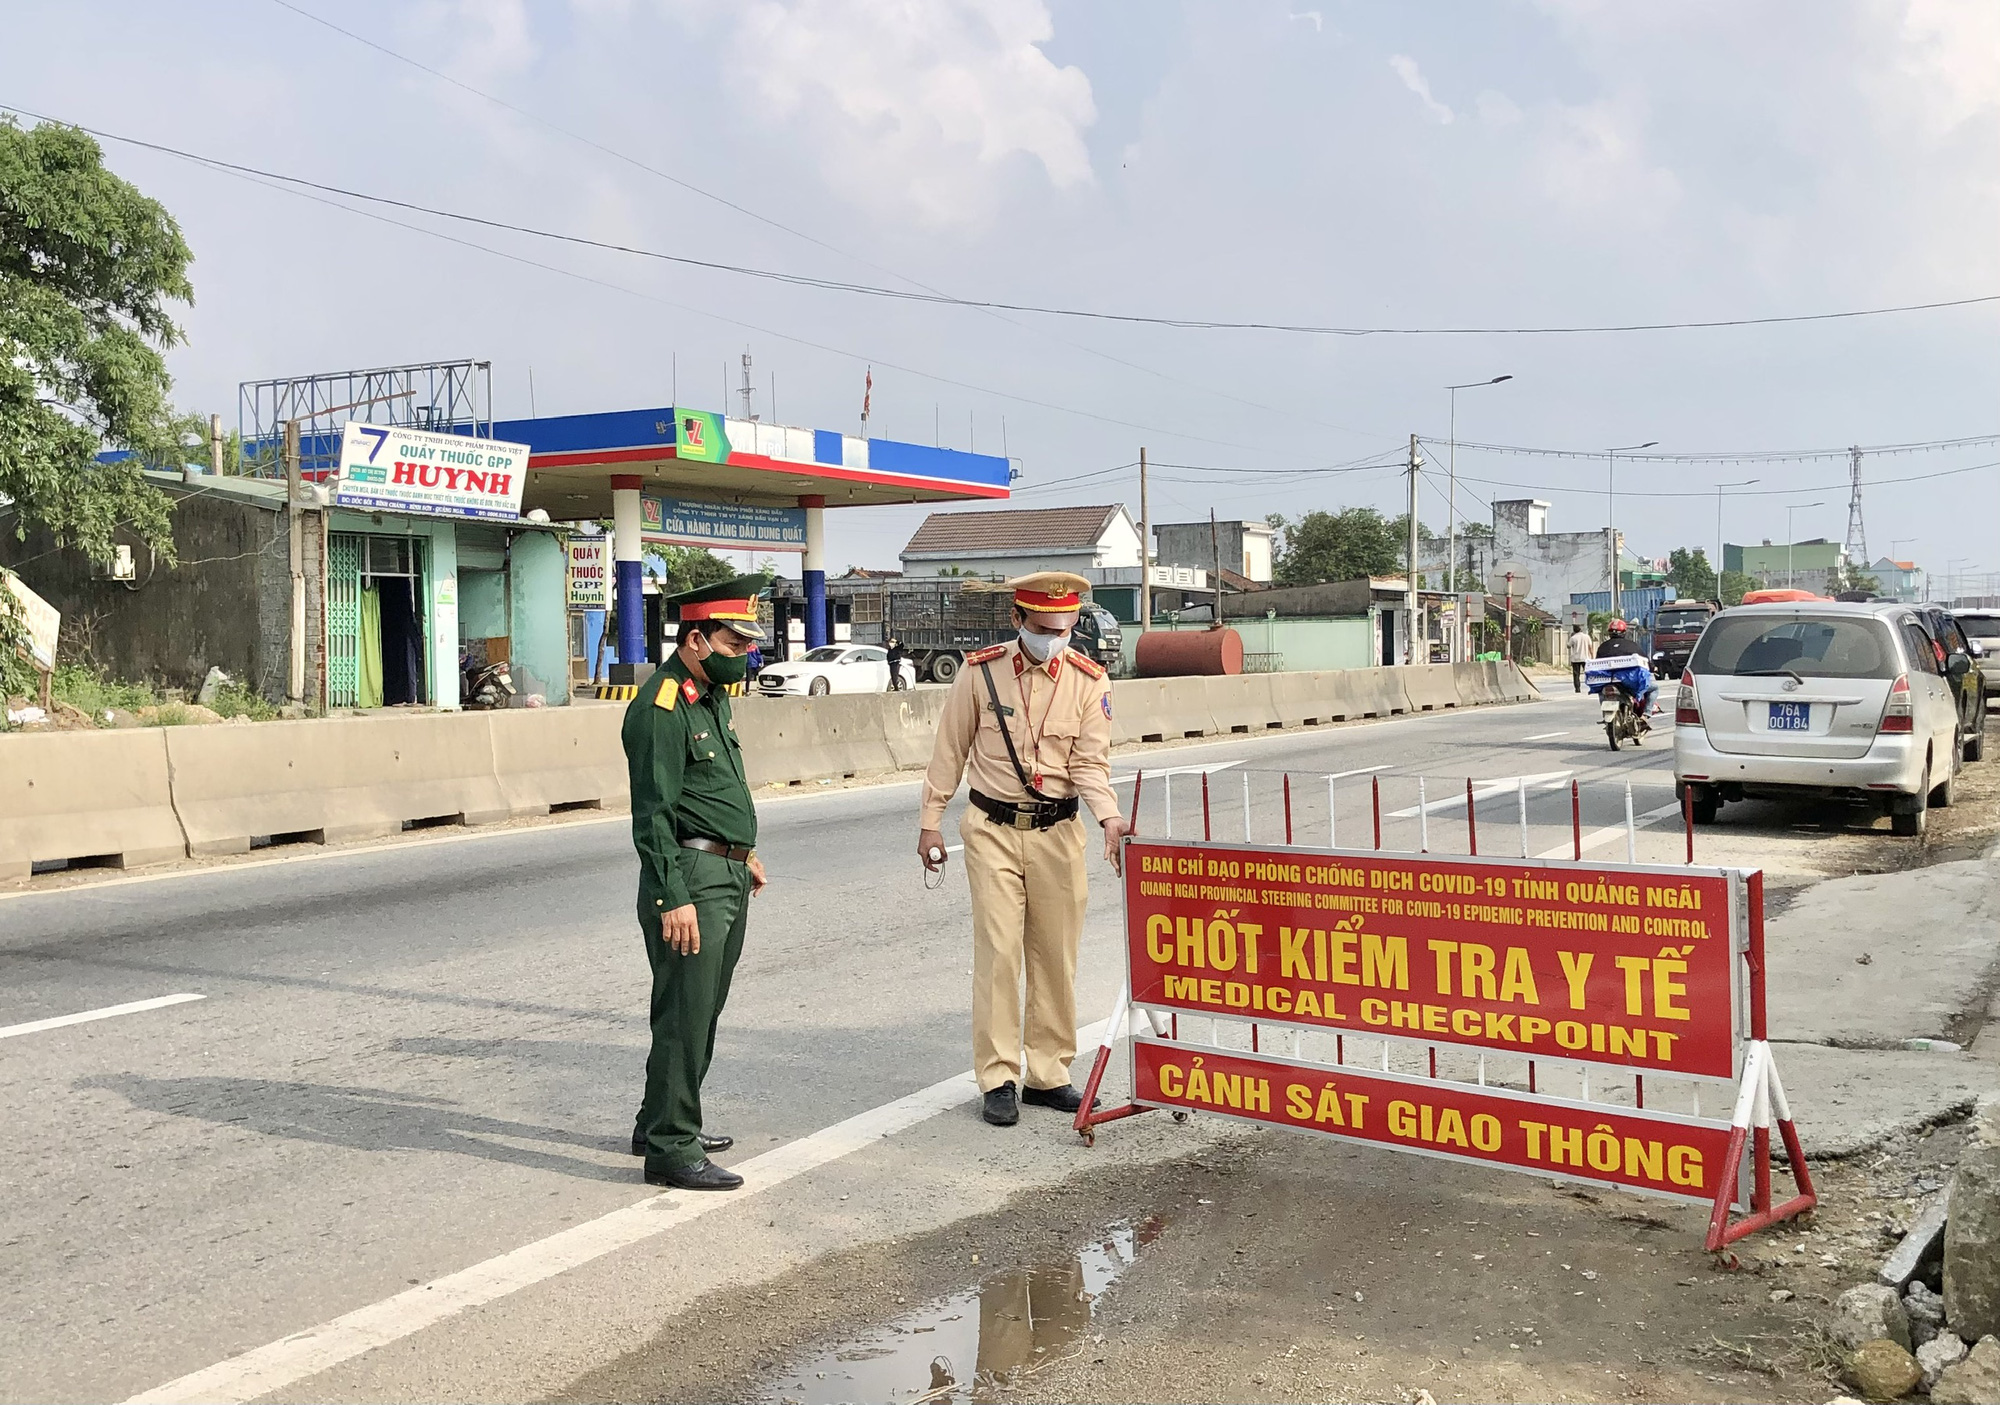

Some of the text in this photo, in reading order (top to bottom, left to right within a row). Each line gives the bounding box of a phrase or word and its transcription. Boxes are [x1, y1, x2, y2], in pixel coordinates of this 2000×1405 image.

[392, 431, 412, 440] CÔNG
[424, 436, 444, 444] TNHH
[444, 438, 464, 448] DƯỢC
[486, 444, 506, 453] TRUNG
[508, 447, 523, 456] VIỆT
[440, 450, 483, 466] THUỐC
[487, 456, 512, 469] GPP
[392, 461, 512, 495] HUYNH
[666, 515, 803, 541] CỬA HÀNG XĂNG DẦU DUNG QUẤT
[570, 563, 604, 578] THUỐC
[571, 590, 604, 602] Huynh
[572, 581, 603, 589] GPP
[1779, 704, 1800, 717] 76A
[1769, 717, 1808, 730] 001.84
[1142, 853, 1702, 910] BAN CHỈ ĐẠO PHÒNG CHỐNG DỊCH COVID-19 TỈNH QUẢNG NGÃI
[1140, 881, 1709, 940] QUANG NGAI PROVINCIAL STEERING COMMITTEE FOR COVID-19 EPIDEMIC PREVENTION AND CONTROL
[1146, 909, 1696, 1021] CHỐT KIỂM TRA Y TẾ
[1164, 974, 1679, 1062] MEDICAL CHECKPOINT
[1159, 1057, 1704, 1188] CẢNH SÁT GIAO THÔNG
